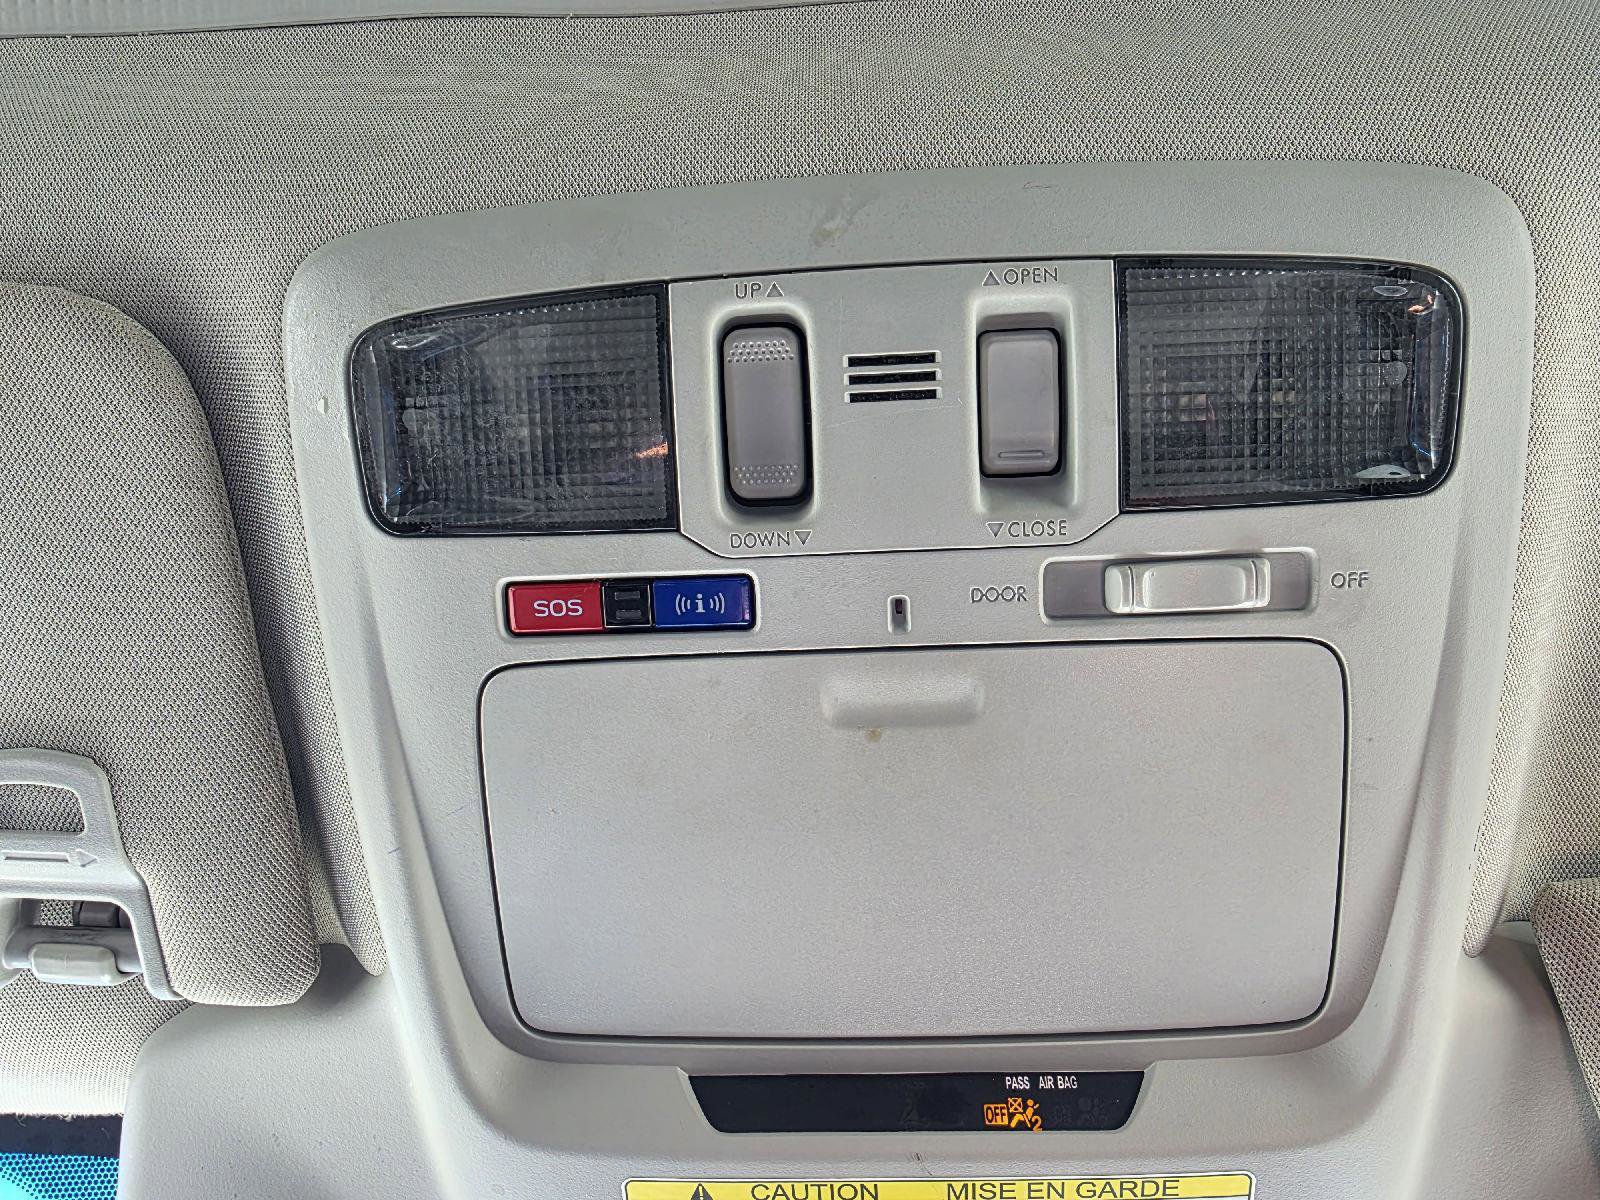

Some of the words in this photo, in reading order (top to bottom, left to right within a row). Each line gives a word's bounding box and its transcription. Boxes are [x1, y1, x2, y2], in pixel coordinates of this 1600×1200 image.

[1003, 267, 1059, 285] OPEN
[734, 282, 762, 299] UP
[1008, 519, 1068, 538] CLOSE
[730, 531, 791, 550] DOWN
[1330, 570, 1370, 589] OFF
[970, 585, 1029, 604] DOOR
[533, 598, 583, 617] SOS
[1005, 1076, 1031, 1090] PASS
[1038, 1075, 1055, 1089] AIR
[1056, 1075, 1078, 1089] BAG
[985, 1104, 1007, 1124] OFF
[750, 1183, 879, 1200] CAUTION
[946, 1182, 1017, 1200] MISE
[1026, 1181, 1065, 1200] EN
[1075, 1179, 1180, 1200] GARDE
